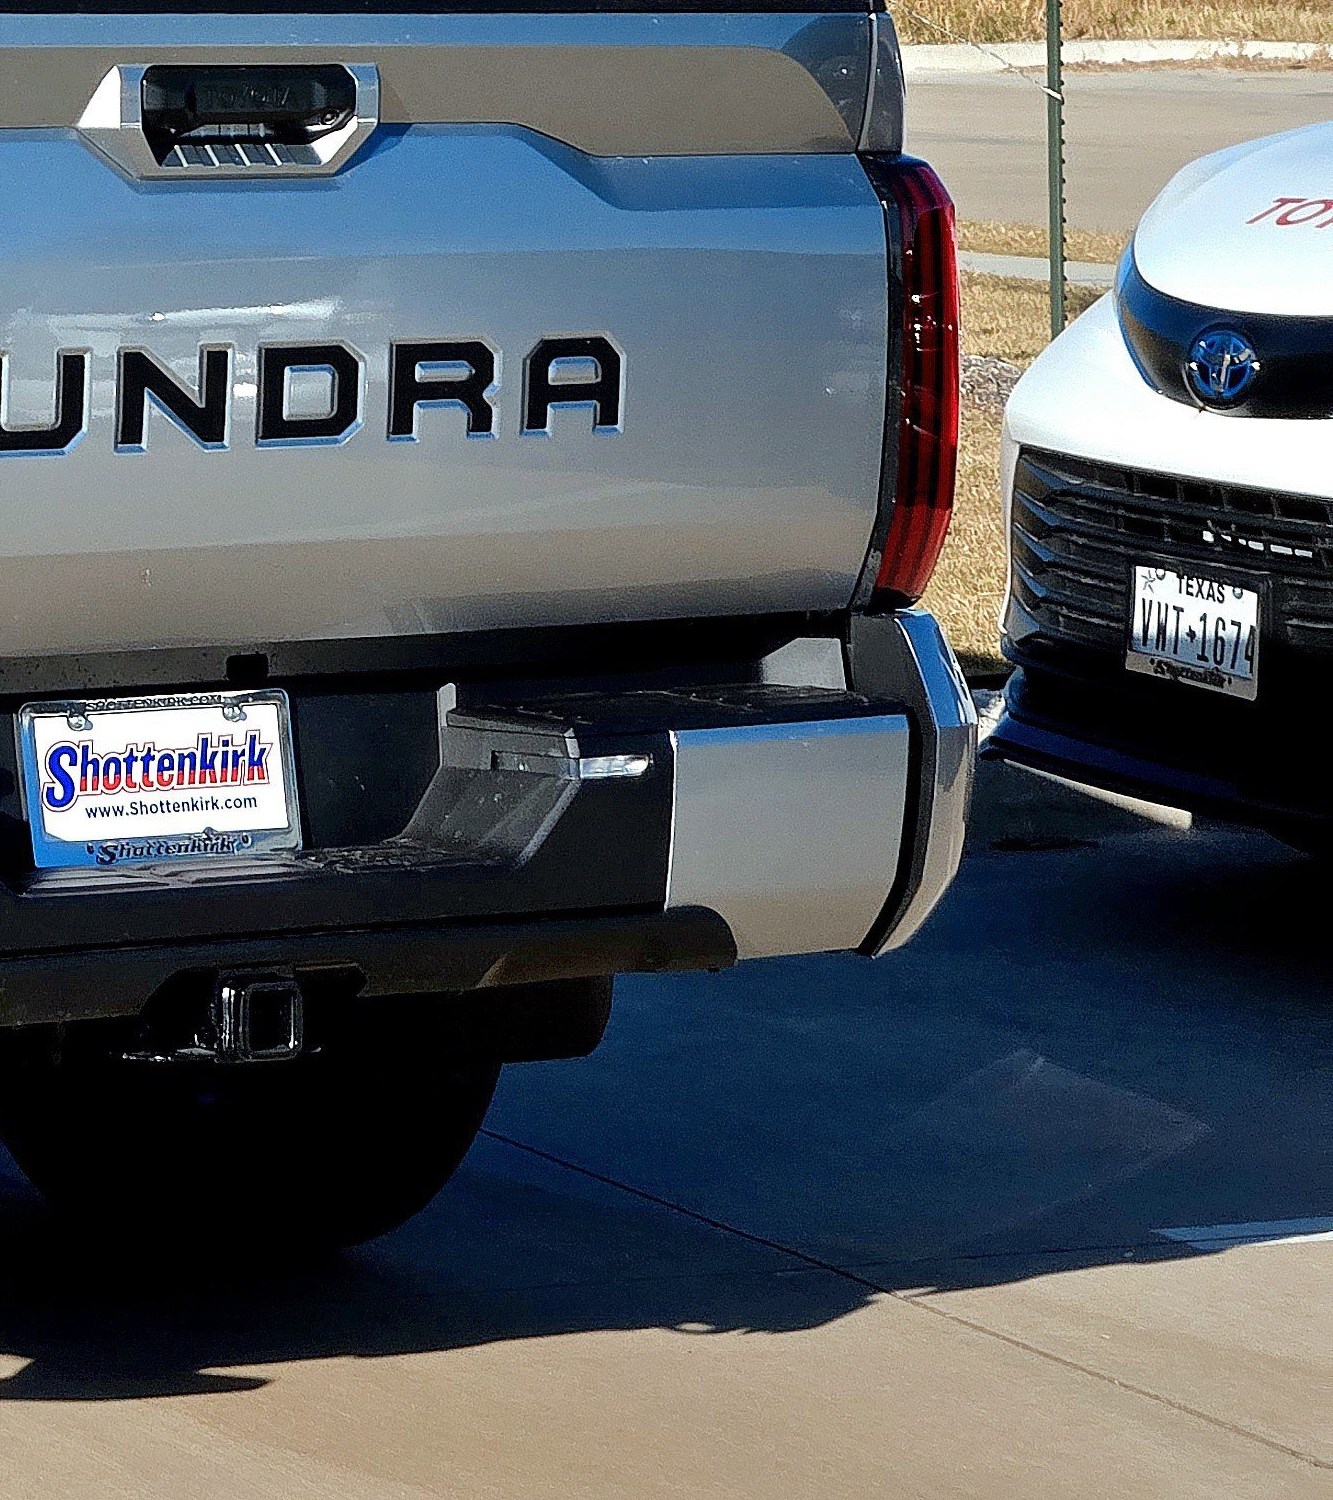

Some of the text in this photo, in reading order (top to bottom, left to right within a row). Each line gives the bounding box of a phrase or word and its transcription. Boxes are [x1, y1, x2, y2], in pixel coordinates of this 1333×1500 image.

[1245, 198, 1333, 229] TO
[1176, 575, 1225, 603] TEXAS
[1196, 612, 1256, 675] 1674
[44, 730, 270, 809] Shottenkirk
[85, 796, 258, 819] www.Shottenkirk.com
